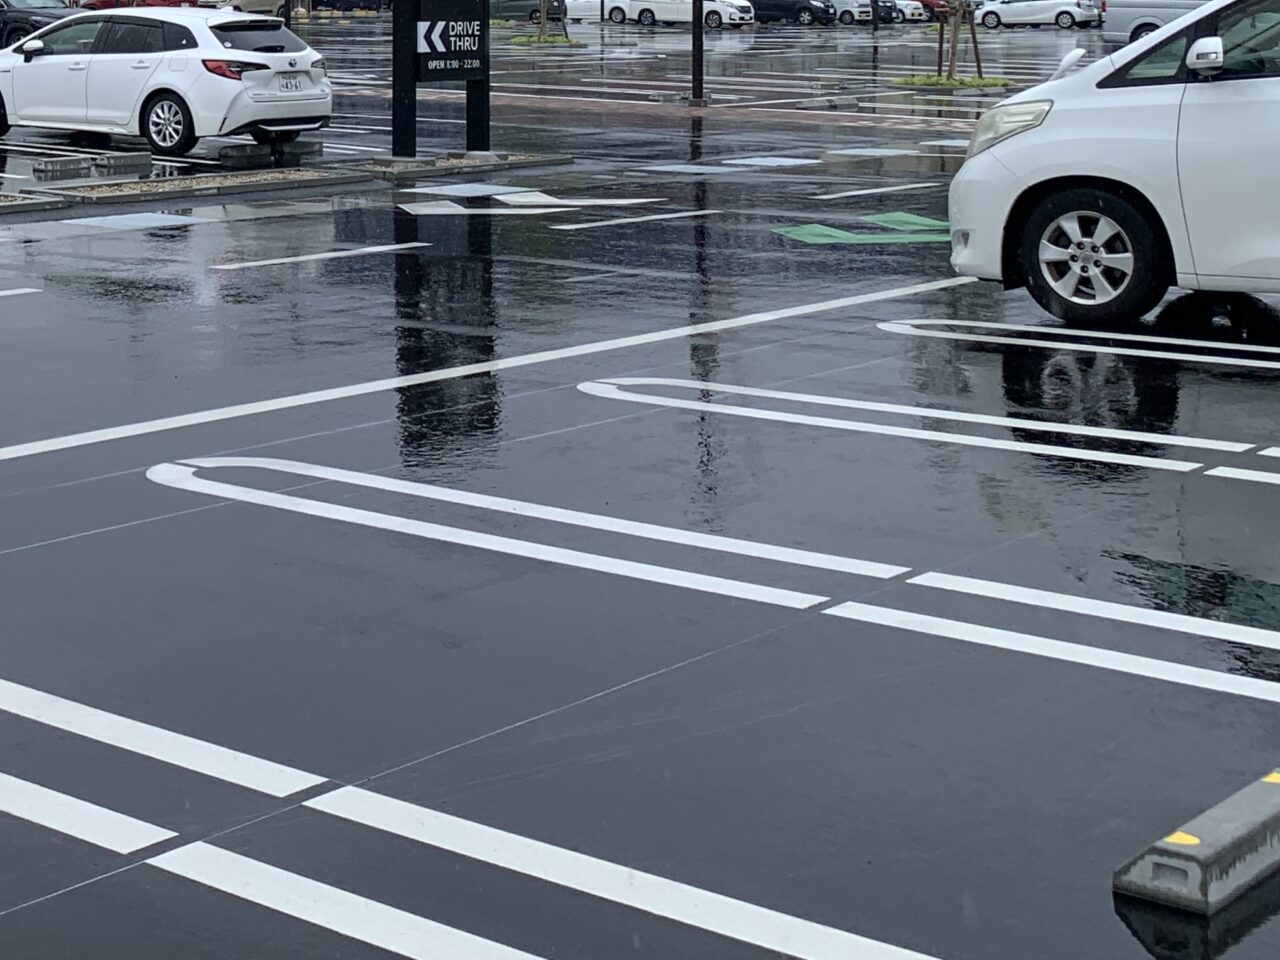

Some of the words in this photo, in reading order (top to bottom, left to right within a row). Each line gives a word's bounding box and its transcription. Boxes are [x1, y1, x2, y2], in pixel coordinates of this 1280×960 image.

[449, 21, 480, 36] DRIVE
[449, 36, 479, 51] THRU
[428, 60, 445, 70] OPEN
[464, 59, 480, 68] 22:00
